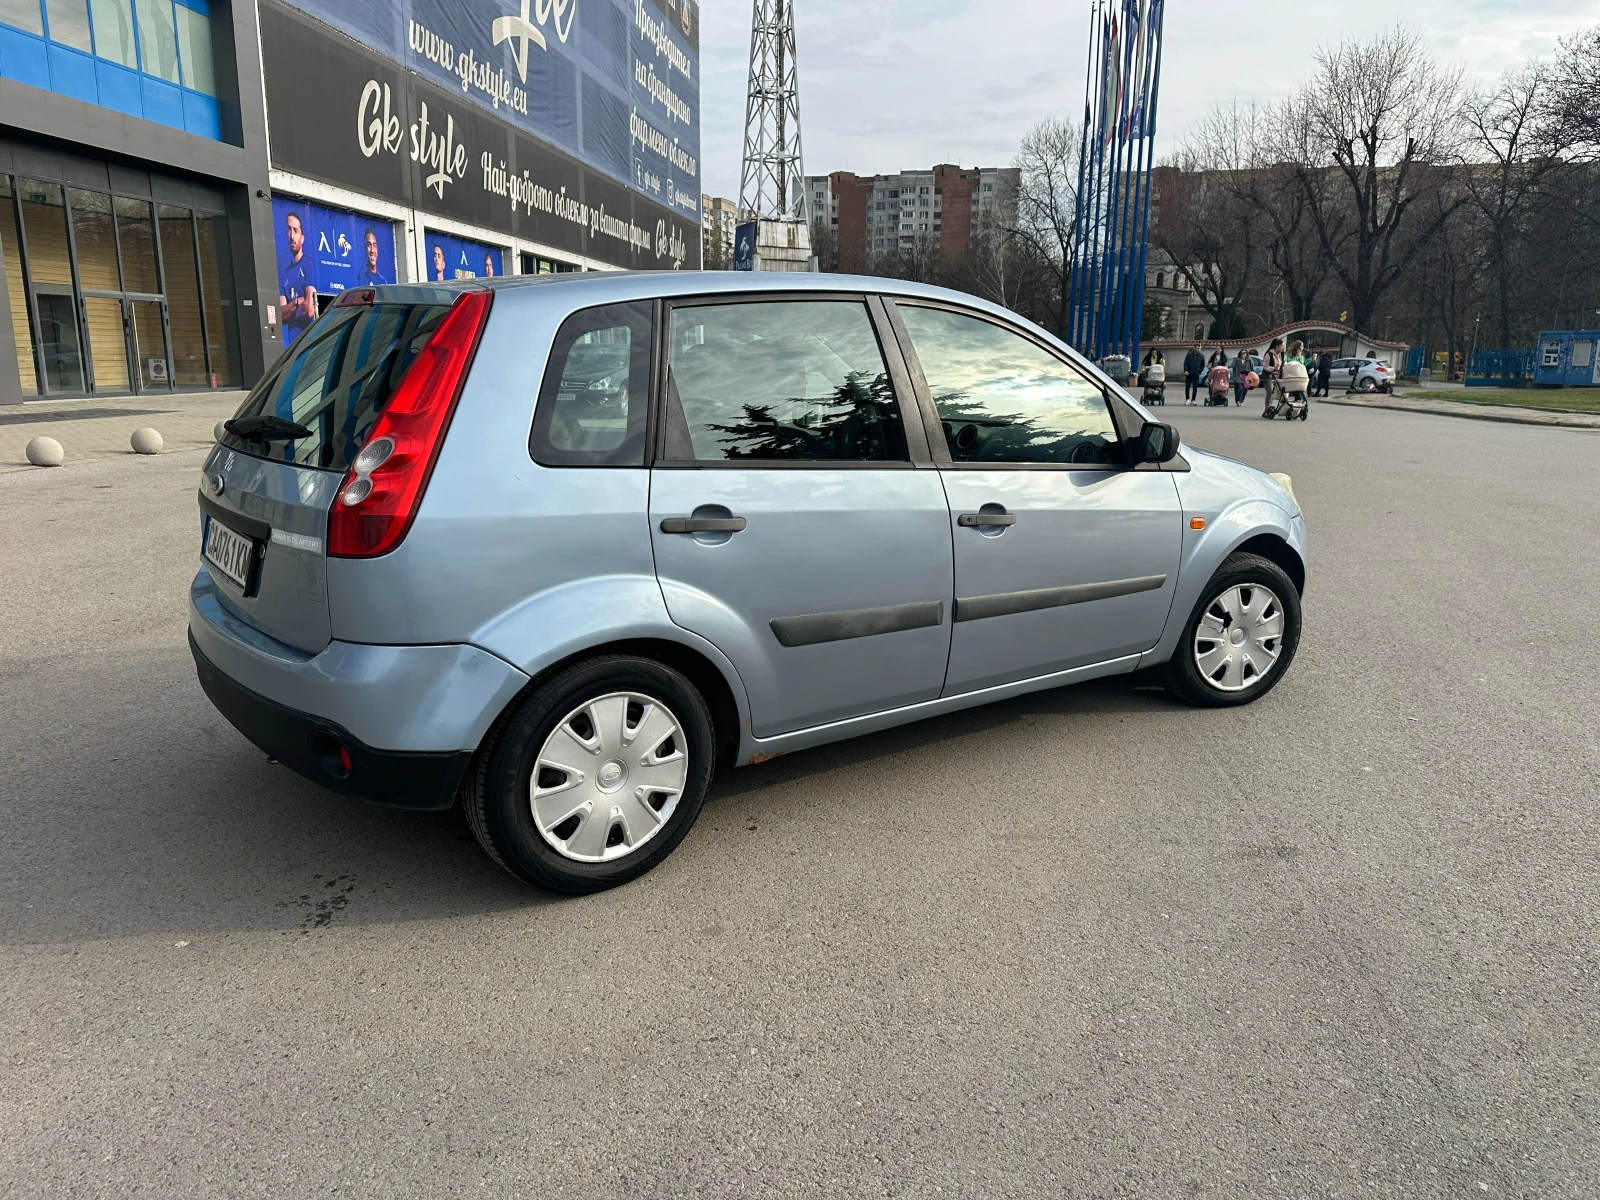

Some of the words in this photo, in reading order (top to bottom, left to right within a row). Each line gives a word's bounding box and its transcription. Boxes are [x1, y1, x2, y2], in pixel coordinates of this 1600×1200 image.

[408, 19, 528, 115] www.gkstyle.eu
[635, 58, 647, 88] на
[647, 62, 691, 126] брандирано
[357, 79, 404, 158] Gk
[410, 101, 469, 200] style
[630, 106, 668, 158] фирмено
[669, 137, 697, 177] облекло
[481, 151, 552, 216] Най-доброто
[554, 186, 588, 227] облекло
[589, 208, 599, 239] за
[655, 219, 669, 259] Gk
